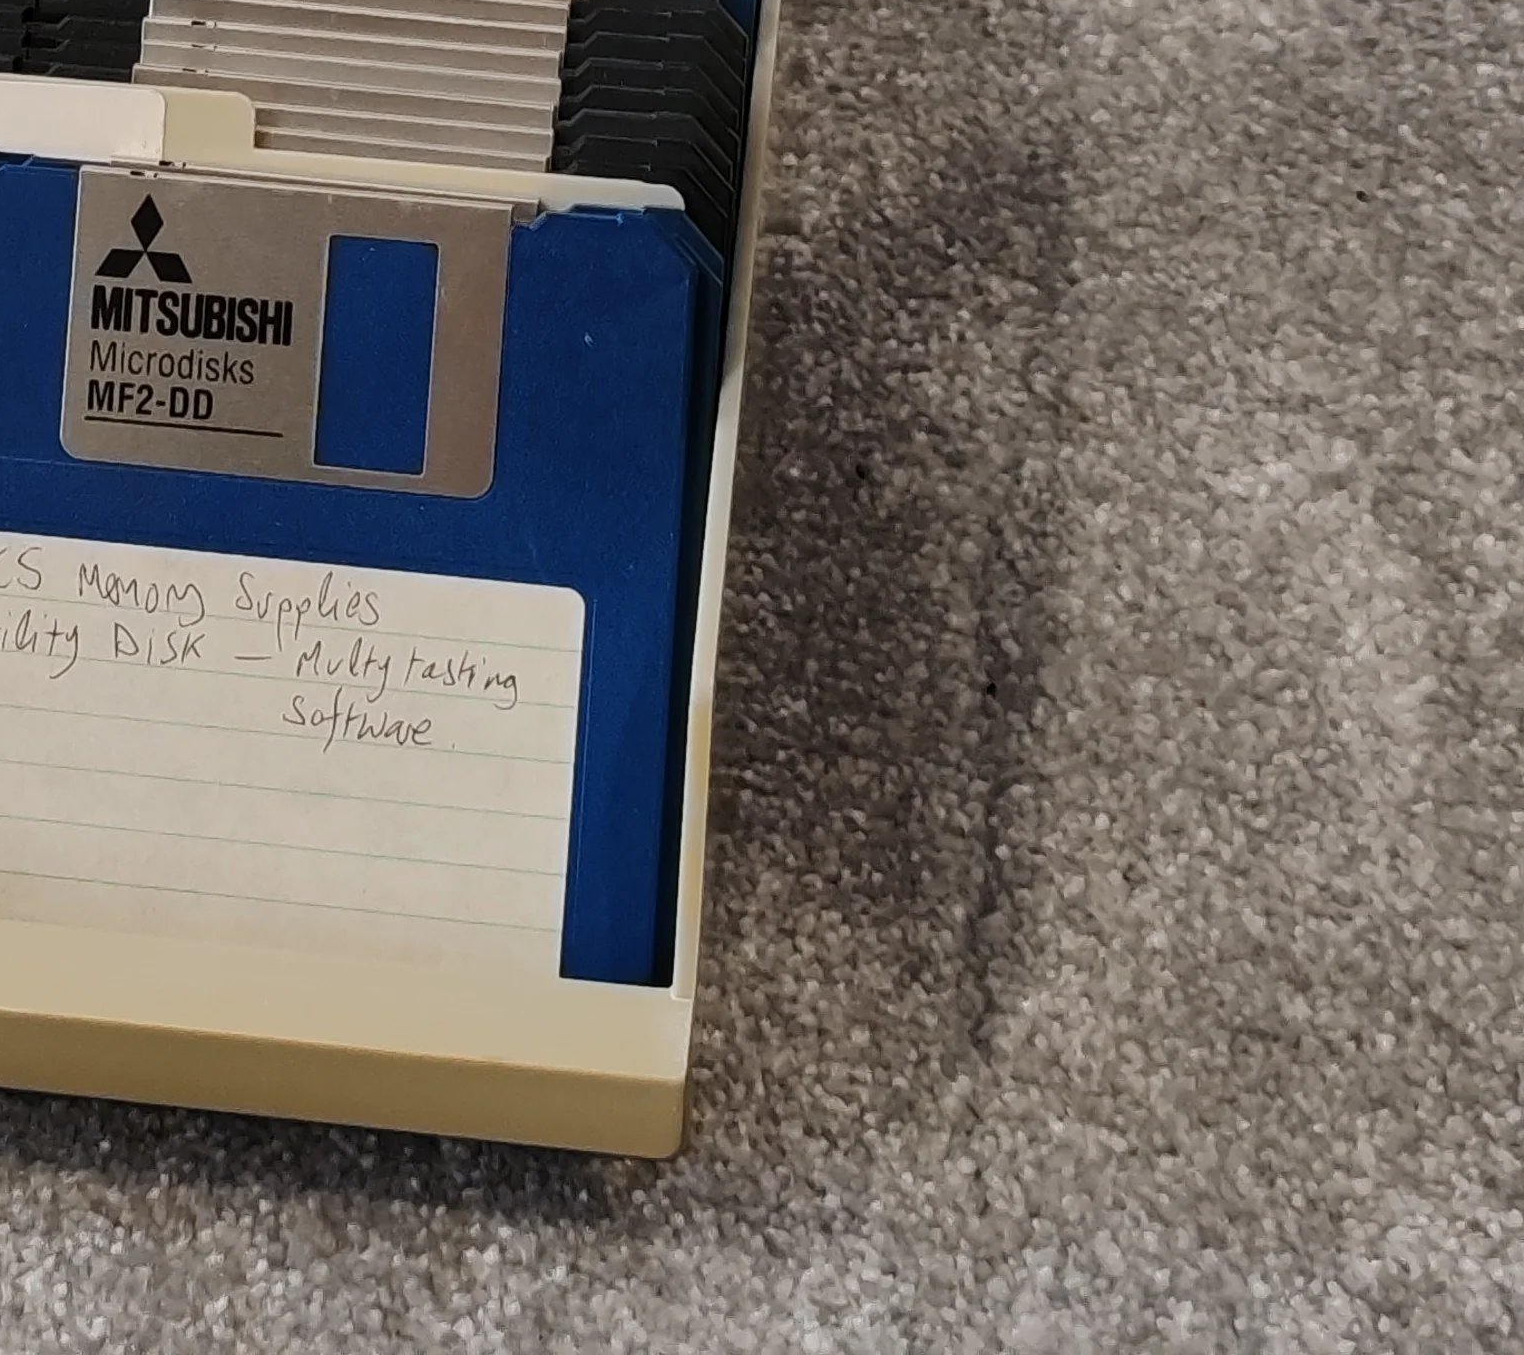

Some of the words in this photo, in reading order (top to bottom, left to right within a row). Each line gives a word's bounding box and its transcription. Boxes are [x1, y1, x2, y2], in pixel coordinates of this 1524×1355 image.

[90, 284, 294, 346] MITSUBISHI
[89, 339, 255, 385] Microdisks
[87, 379, 214, 420] MF2-DD
[235, 570, 380, 652] Supplies
